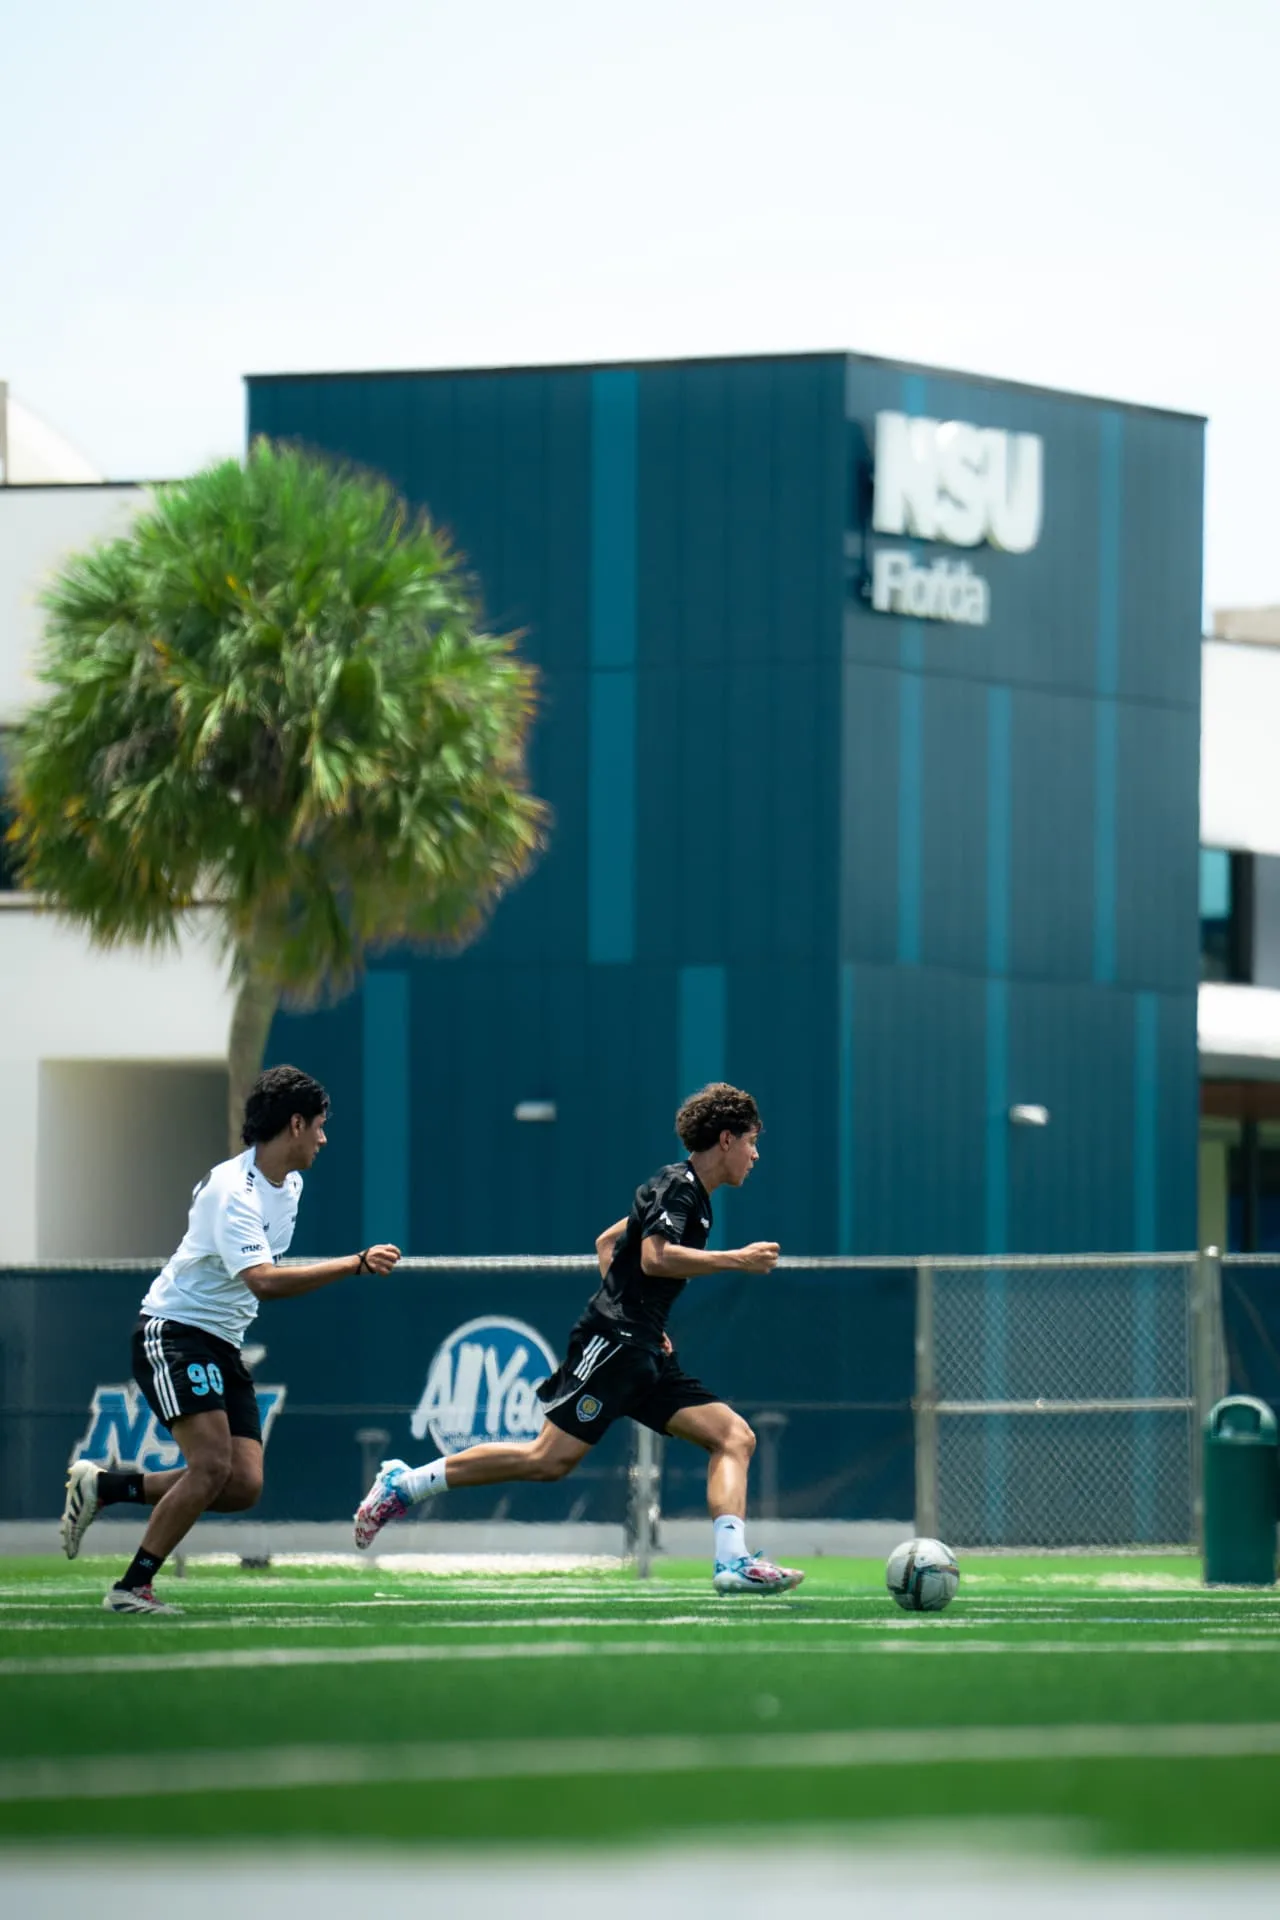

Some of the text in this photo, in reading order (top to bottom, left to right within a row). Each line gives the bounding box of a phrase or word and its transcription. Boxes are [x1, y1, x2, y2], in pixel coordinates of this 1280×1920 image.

[873, 410, 1044, 554] NSU
[187, 1362, 224, 1396] 90
[410, 1342, 547, 1439] AllYea
[70, 1384, 287, 1473] NS
